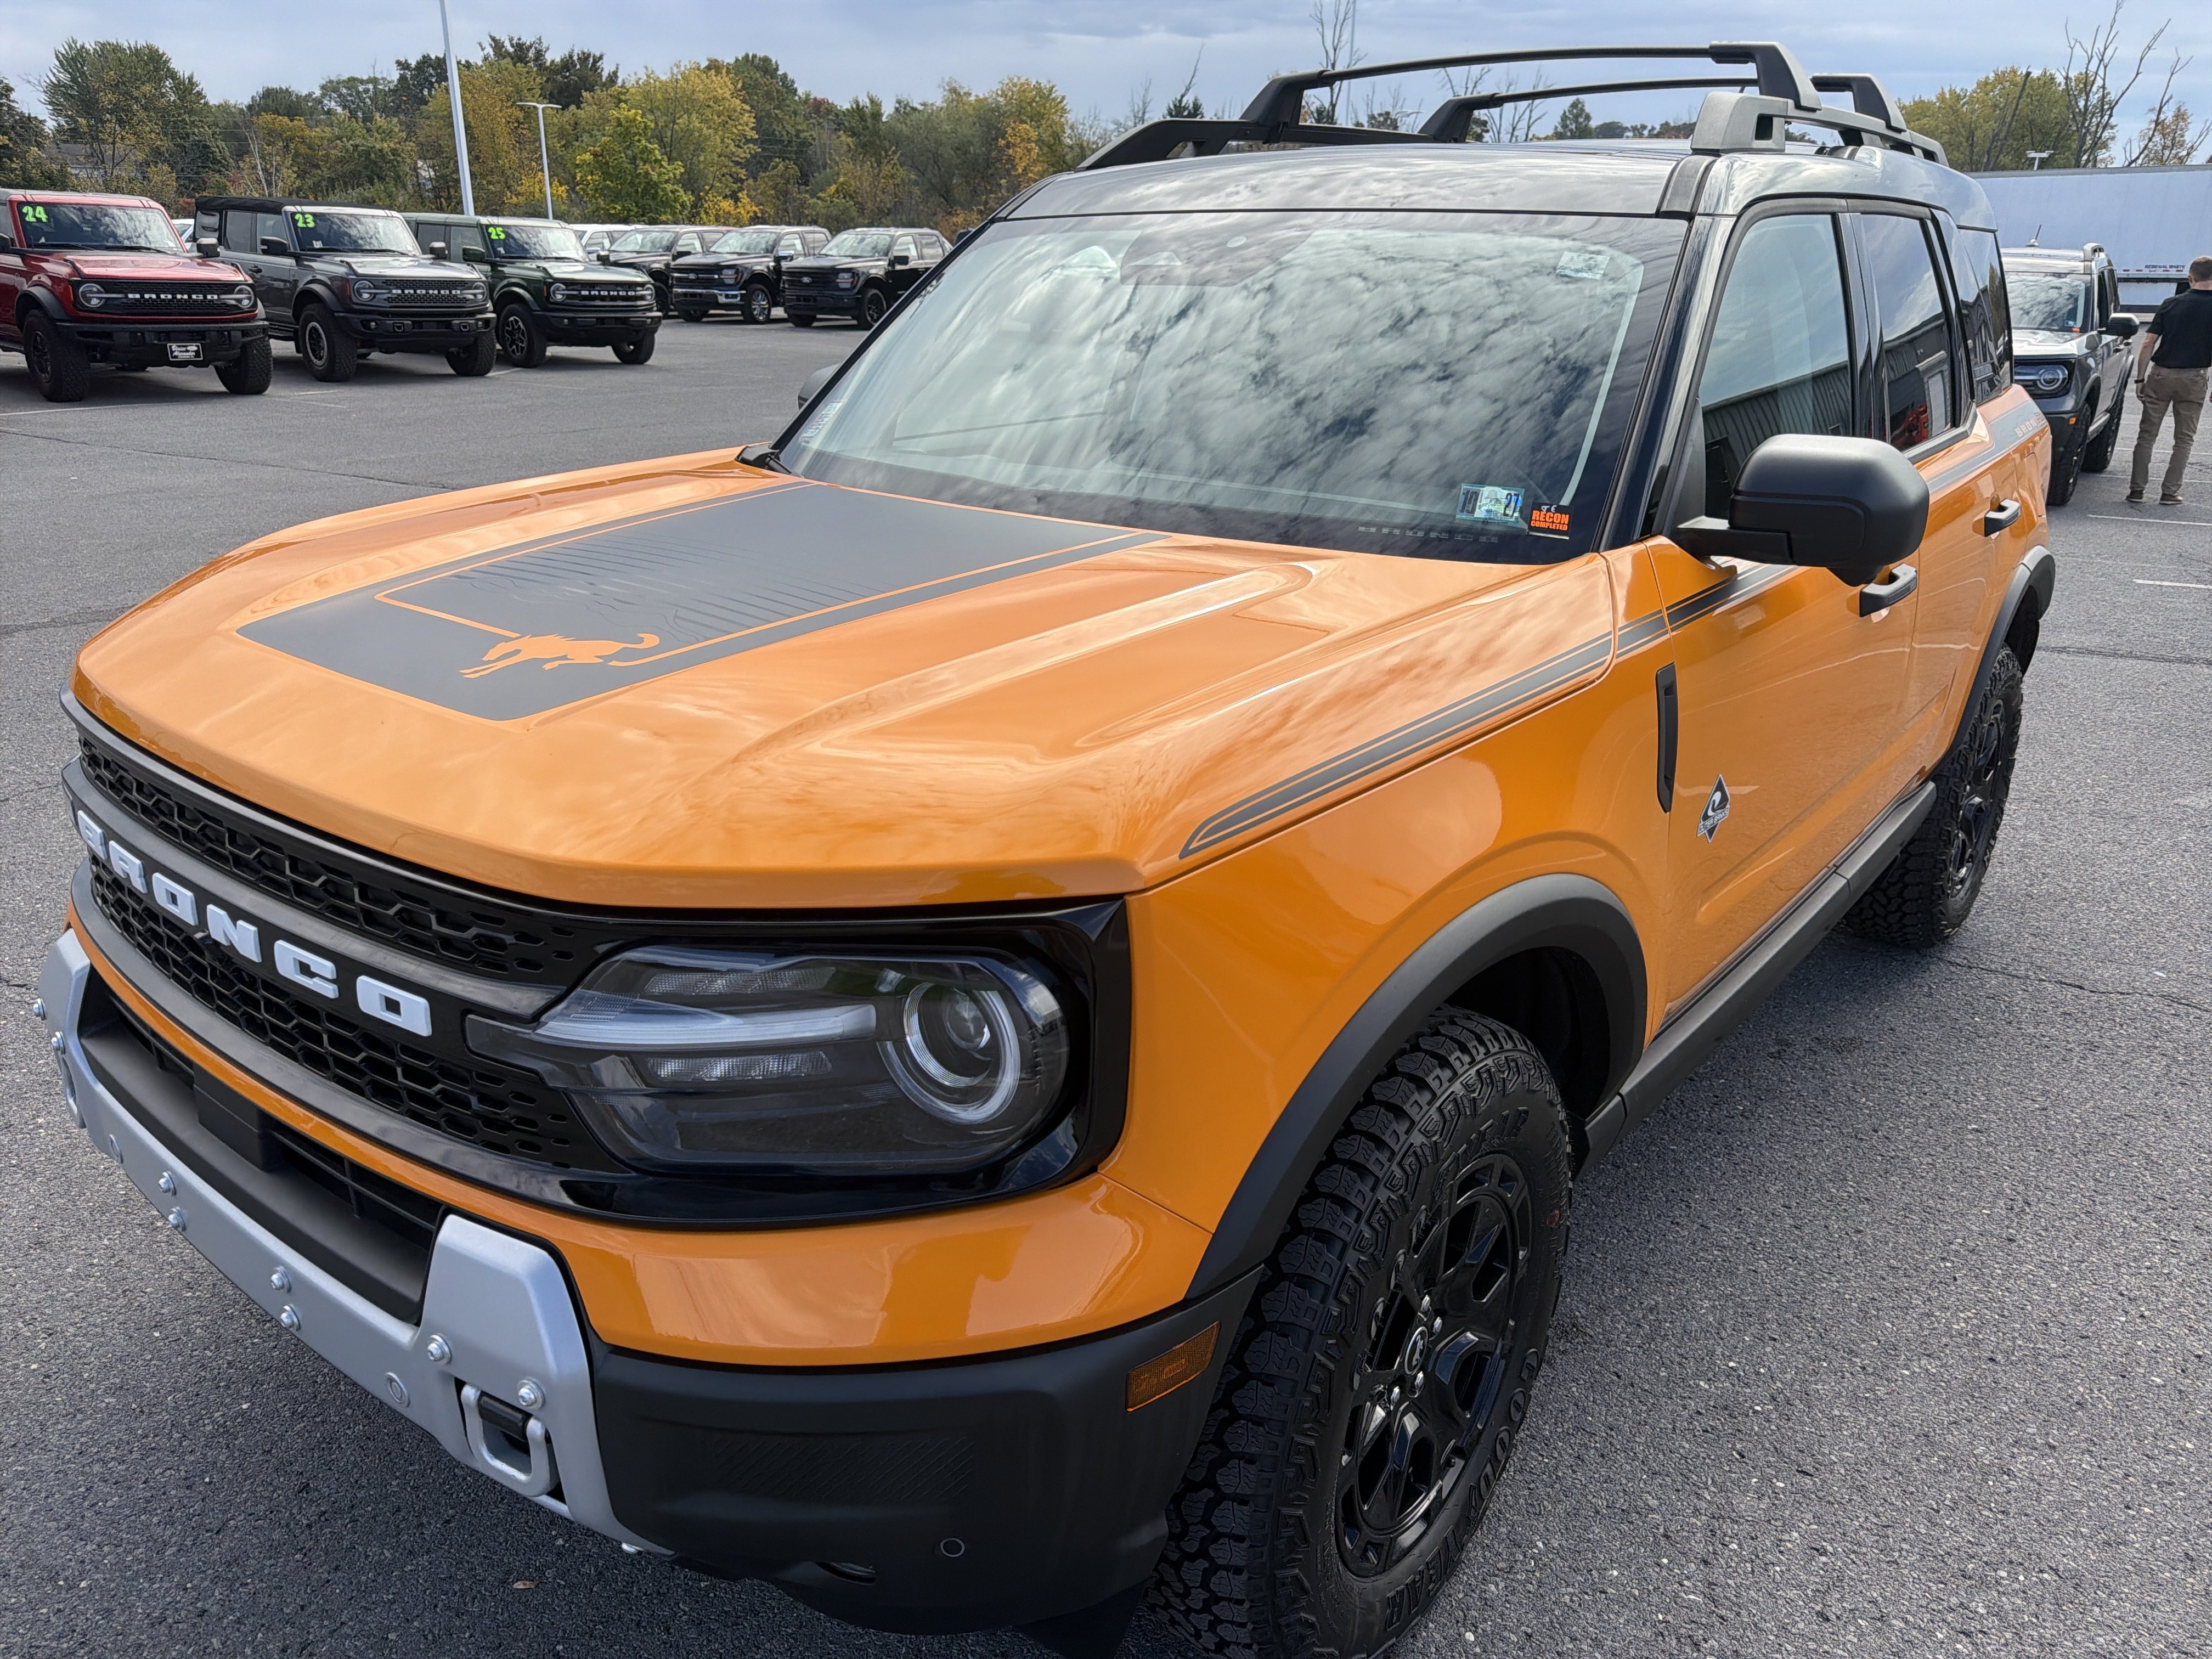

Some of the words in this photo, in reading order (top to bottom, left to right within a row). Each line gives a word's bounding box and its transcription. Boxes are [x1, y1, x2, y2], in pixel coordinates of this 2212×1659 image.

[22, 206, 48, 223] 24
[295, 214, 315, 228] 23
[488, 227, 505, 239] 25
[1503, 492, 1520, 518] 27
[1532, 510, 1569, 524] RECON
[1531, 520, 1568, 531] COMPLETED
[77, 810, 432, 1037] BRONCO
